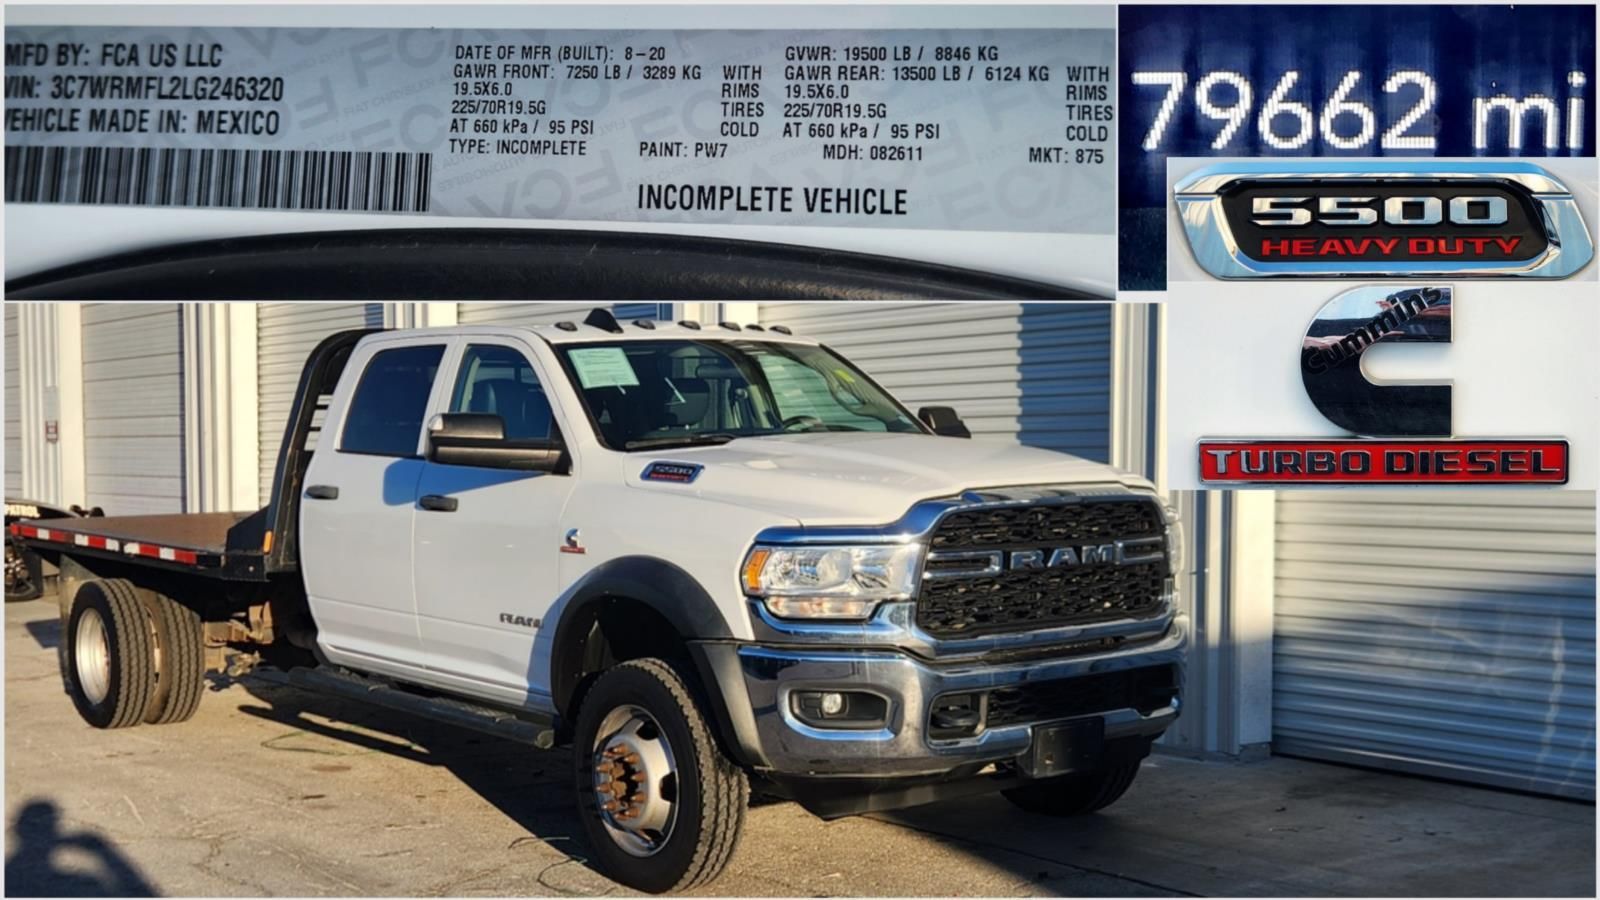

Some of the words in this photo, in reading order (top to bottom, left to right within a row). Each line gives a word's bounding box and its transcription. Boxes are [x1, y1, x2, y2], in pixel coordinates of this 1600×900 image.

[5, 43, 48, 67] MFD
[56, 43, 90, 67] BY:
[101, 44, 140, 67] FCA
[149, 45, 177, 67] US
[185, 46, 223, 67] LLC
[456, 45, 491, 60] DATE
[498, 46, 515, 60] OF
[521, 46, 551, 60] MFR
[558, 46, 614, 63] (BUILT):
[785, 46, 837, 61] GVWR:
[844, 47, 887, 60] 19500
[894, 47, 911, 60] LB
[917, 46, 923, 60] /
[935, 47, 971, 61] 8846
[978, 47, 998, 61] KG
[454, 65, 496, 79] GAWR
[504, 65, 554, 79] FRONT:
[567, 65, 598, 79] 7250
[605, 66, 621, 79] LB
[626, 66, 632, 79] /
[643, 66, 676, 80] 3289
[683, 66, 701, 80] KG
[723, 66, 761, 80] WITH
[784, 66, 831, 81] GAWR
[838, 66, 885, 81] REAR:
[892, 67, 936, 81] 13500
[943, 67, 961, 81] LB
[967, 67, 973, 81] /
[985, 67, 1021, 81] 6124
[1028, 67, 1049, 81] KG
[1067, 67, 1110, 82] WITH
[5, 75, 41, 98] VIN:
[51, 75, 284, 102] 3C7WRMFL2LG246320
[453, 82, 512, 96] 19.5X6.0
[721, 83, 759, 97] RIMS
[785, 84, 849, 99] 19.5X6.0
[1066, 85, 1107, 100] RIMS
[451, 100, 546, 115] 225/70R19.5G
[721, 102, 764, 117] TIRES
[783, 103, 887, 118] 225/70R19.5G
[1066, 105, 1113, 121] TIRES
[1131, 70, 1438, 150] 79662
[1472, 70, 1587, 149] mi
[89, 108, 149, 133] MADE
[158, 109, 187, 133] IN:
[196, 110, 280, 136] MEXICO
[450, 119, 468, 133] AT
[474, 119, 497, 133] 660
[503, 119, 527, 134] kPa
[533, 120, 539, 134] /
[549, 120, 565, 134] 95
[571, 120, 593, 135] PSI
[721, 122, 758, 137] COLD
[783, 123, 802, 138] AT
[808, 124, 834, 138] 660
[840, 124, 867, 139] kPa
[873, 124, 879, 138] /
[891, 124, 909, 139] 95
[915, 124, 940, 139] PSI
[1066, 126, 1108, 142] COLD
[449, 139, 490, 154] TYPE:
[496, 140, 586, 155] INCOMPLETE
[639, 142, 687, 157] PAINT:
[695, 143, 728, 158] PW7
[823, 145, 863, 160] MDH:
[870, 145, 923, 161] 082611
[1029, 147, 1069, 163] MKT:
[1075, 149, 1104, 164] 875
[638, 184, 792, 212] INCOMPLETE
[804, 187, 907, 215] VEHICLE
[1250, 196, 1508, 227] 5500
[1261, 238, 1399, 257] HEAVY
[1408, 237, 1522, 256] DUTY
[1302, 287, 1444, 375] Cummins
[1207, 450, 1373, 476] TURBO
[1384, 449, 1561, 475] DIESEL
[1010, 544, 1116, 571] RAM
[500, 613, 544, 629] RAM
